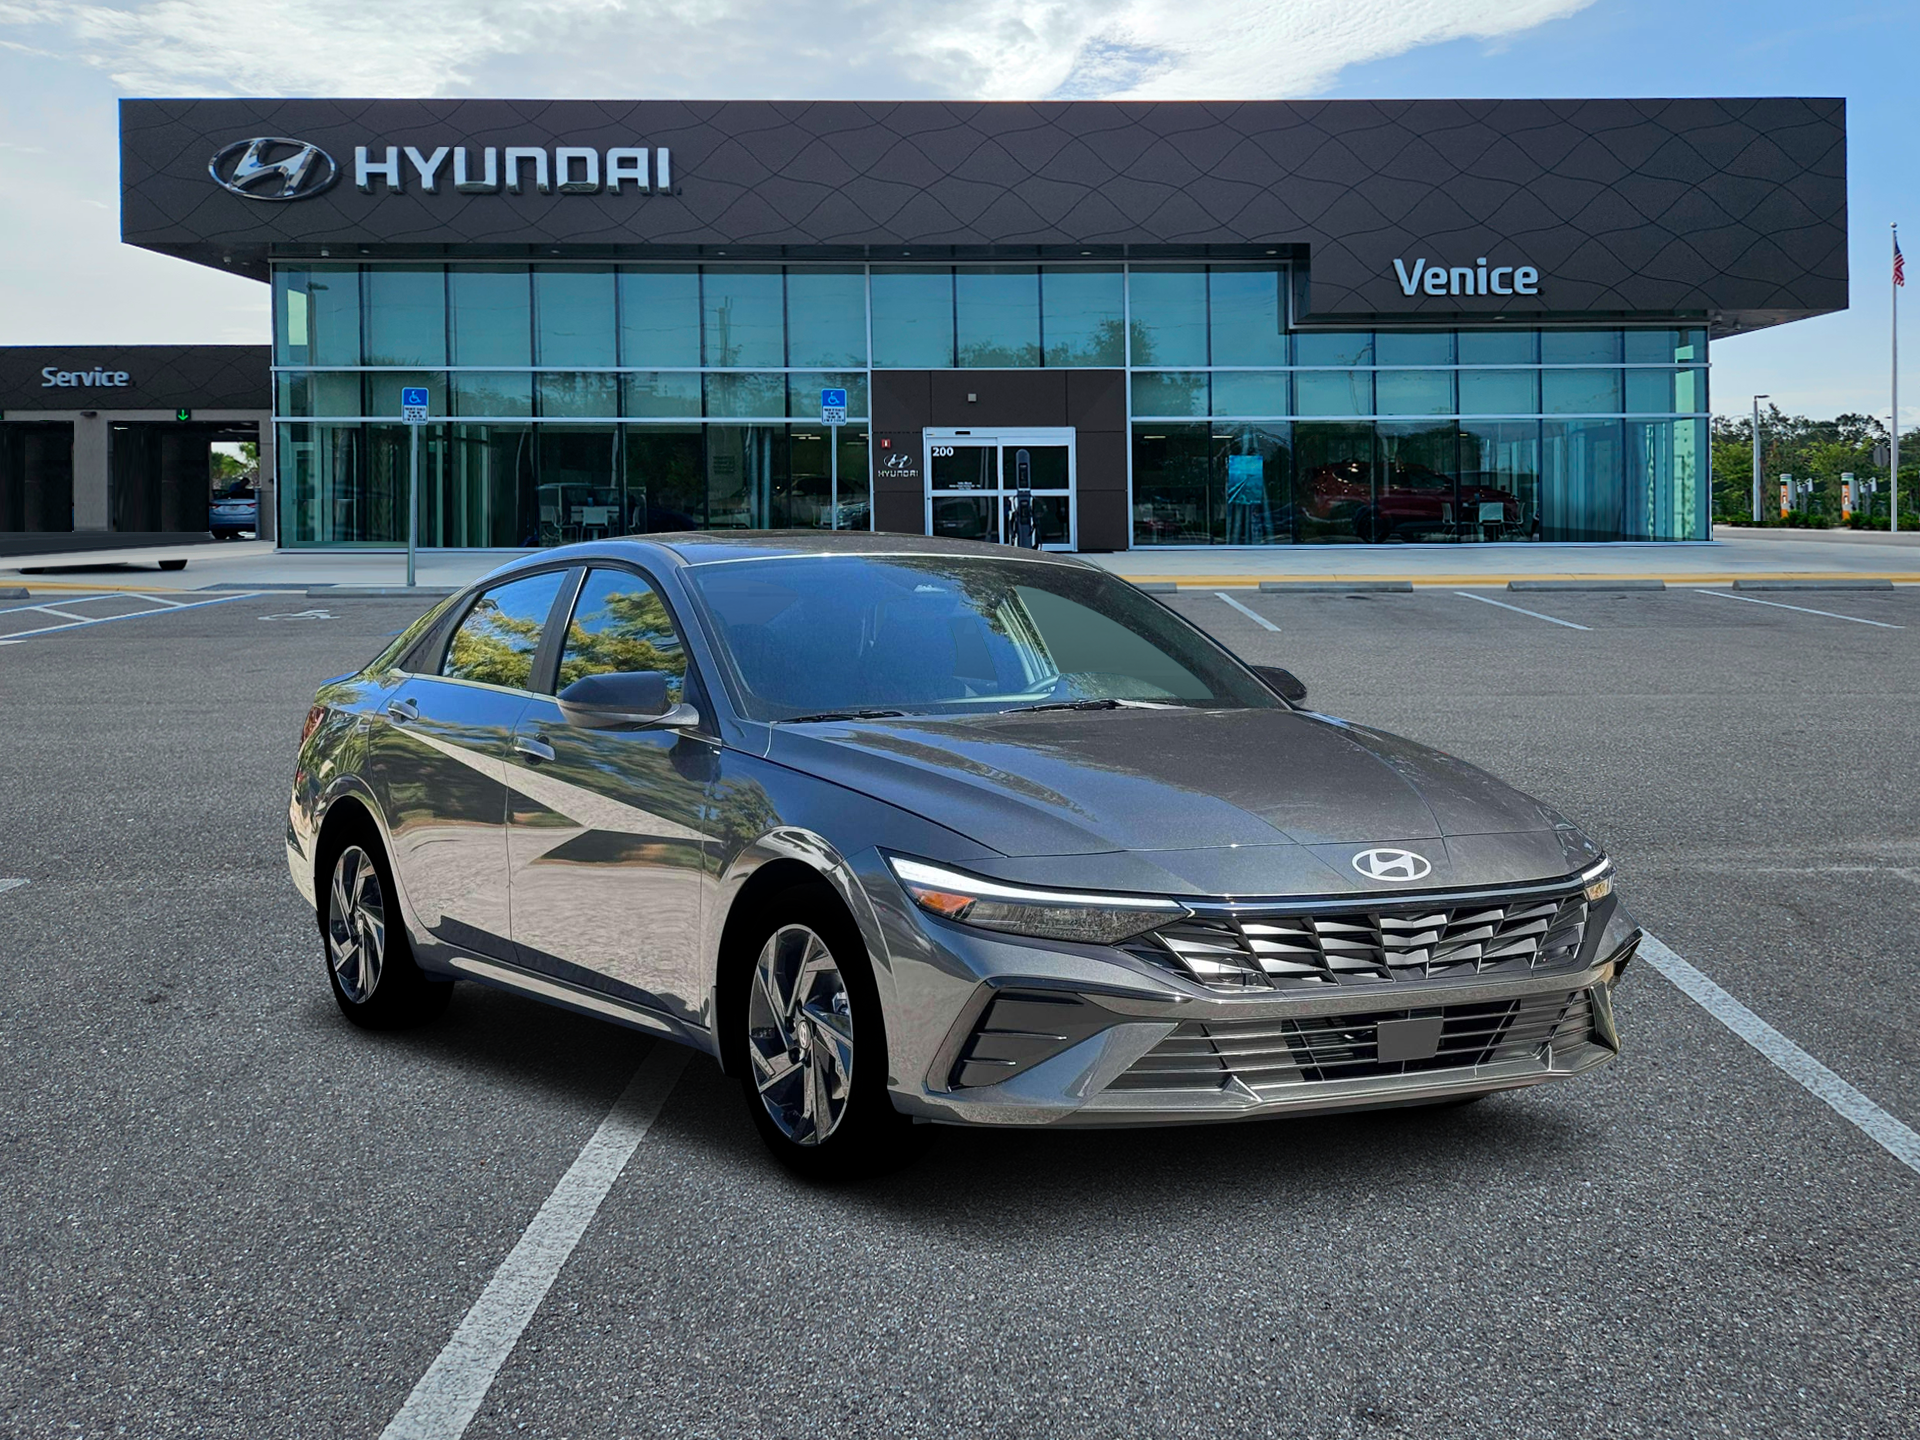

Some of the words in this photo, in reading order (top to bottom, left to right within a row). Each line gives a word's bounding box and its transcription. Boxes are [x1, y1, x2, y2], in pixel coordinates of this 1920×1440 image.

[355, 147, 671, 192] HYUNDAI
[1393, 257, 1538, 295] Venice
[41, 367, 130, 387] Service
[932, 447, 954, 456] 200
[878, 470, 918, 478] HYUNDAI
